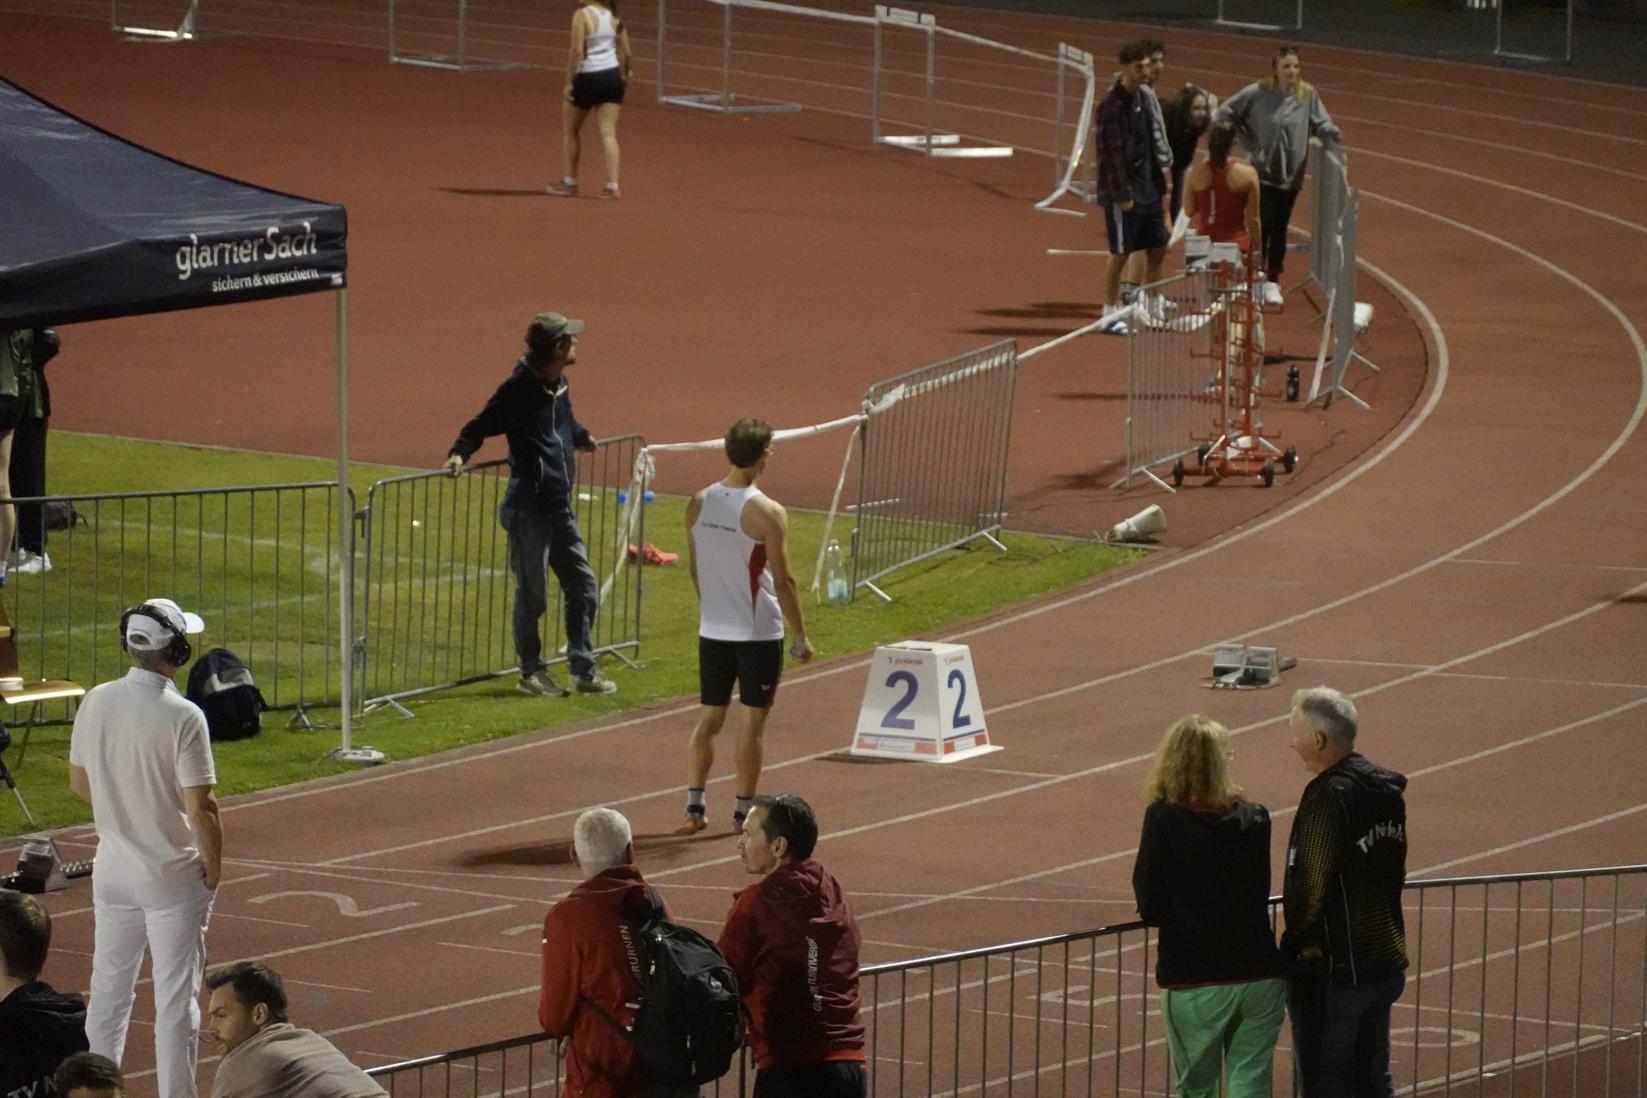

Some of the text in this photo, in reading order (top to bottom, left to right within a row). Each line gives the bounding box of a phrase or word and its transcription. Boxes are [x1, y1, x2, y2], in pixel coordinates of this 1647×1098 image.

[880, 669, 919, 730] 2
[947, 668, 971, 729] 2
[247, 890, 424, 918] 2
